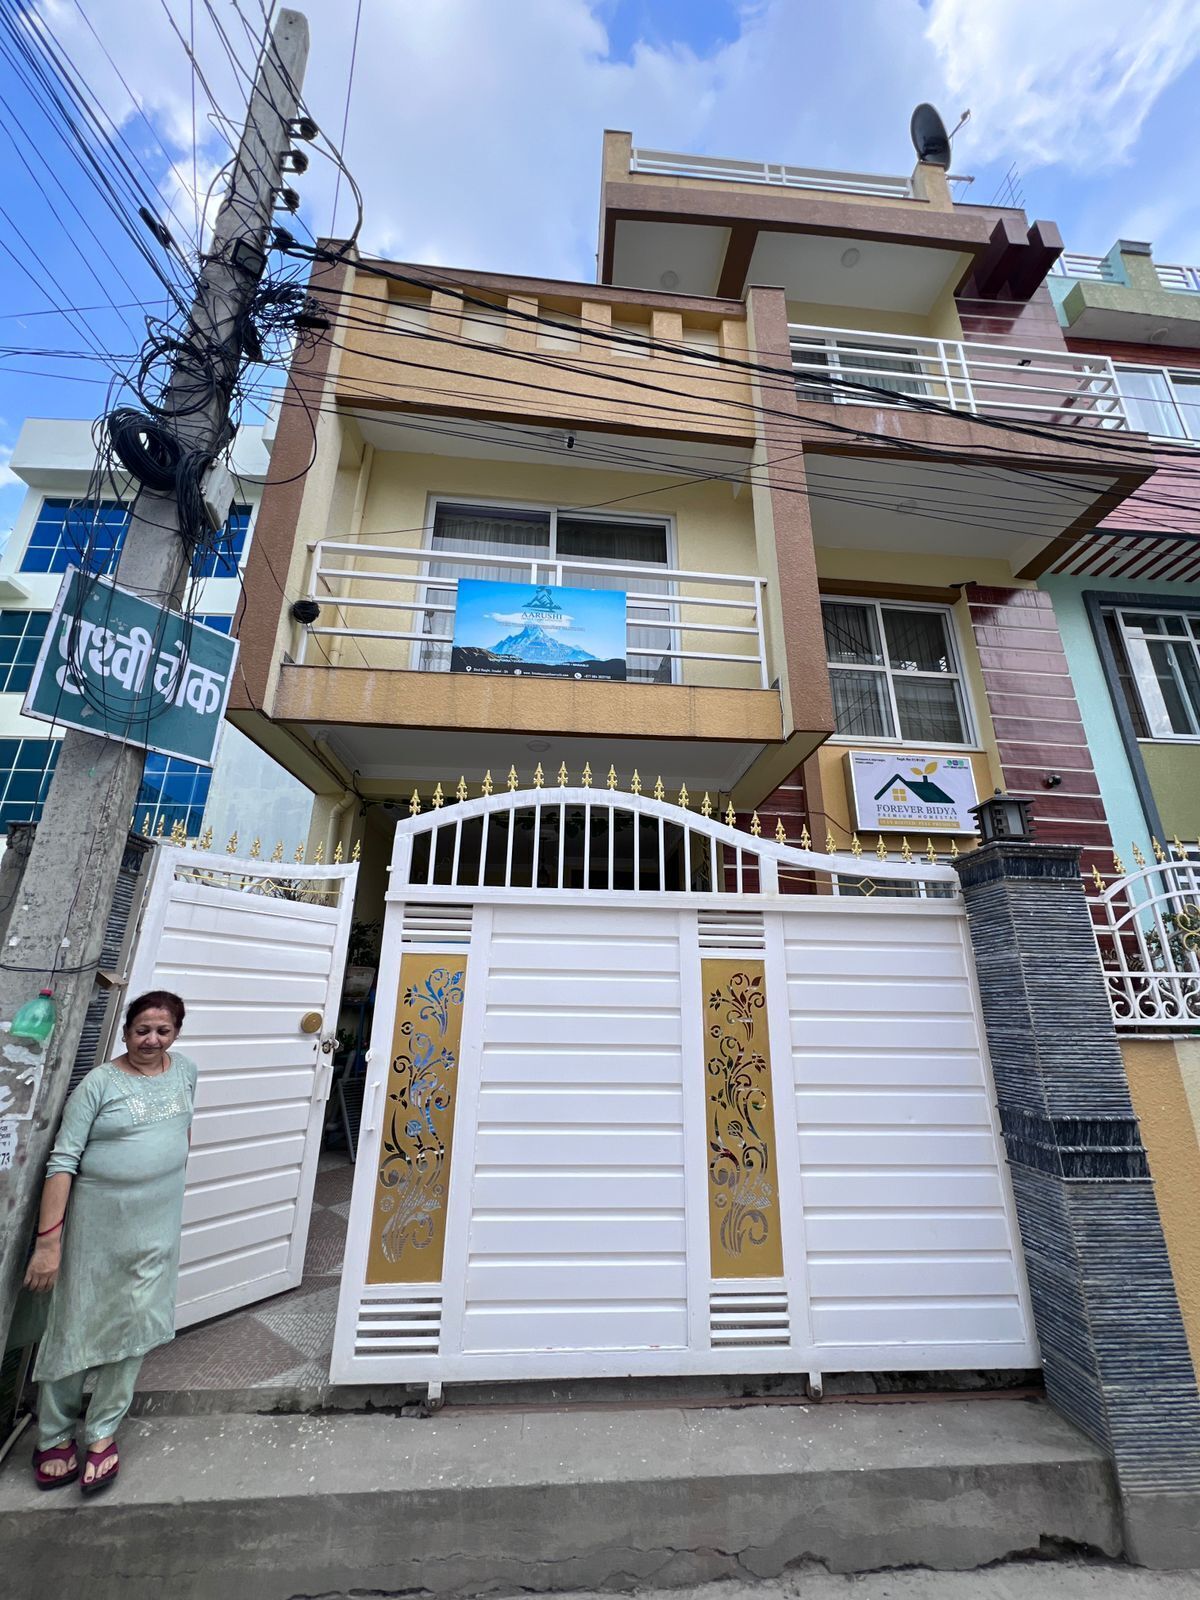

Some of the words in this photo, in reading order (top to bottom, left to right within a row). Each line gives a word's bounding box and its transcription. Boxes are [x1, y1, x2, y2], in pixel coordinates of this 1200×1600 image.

[521, 611, 562, 620] AARUSHI
[877, 804, 924, 814] FOREVER
[926, 806, 957, 815] BIDYA
